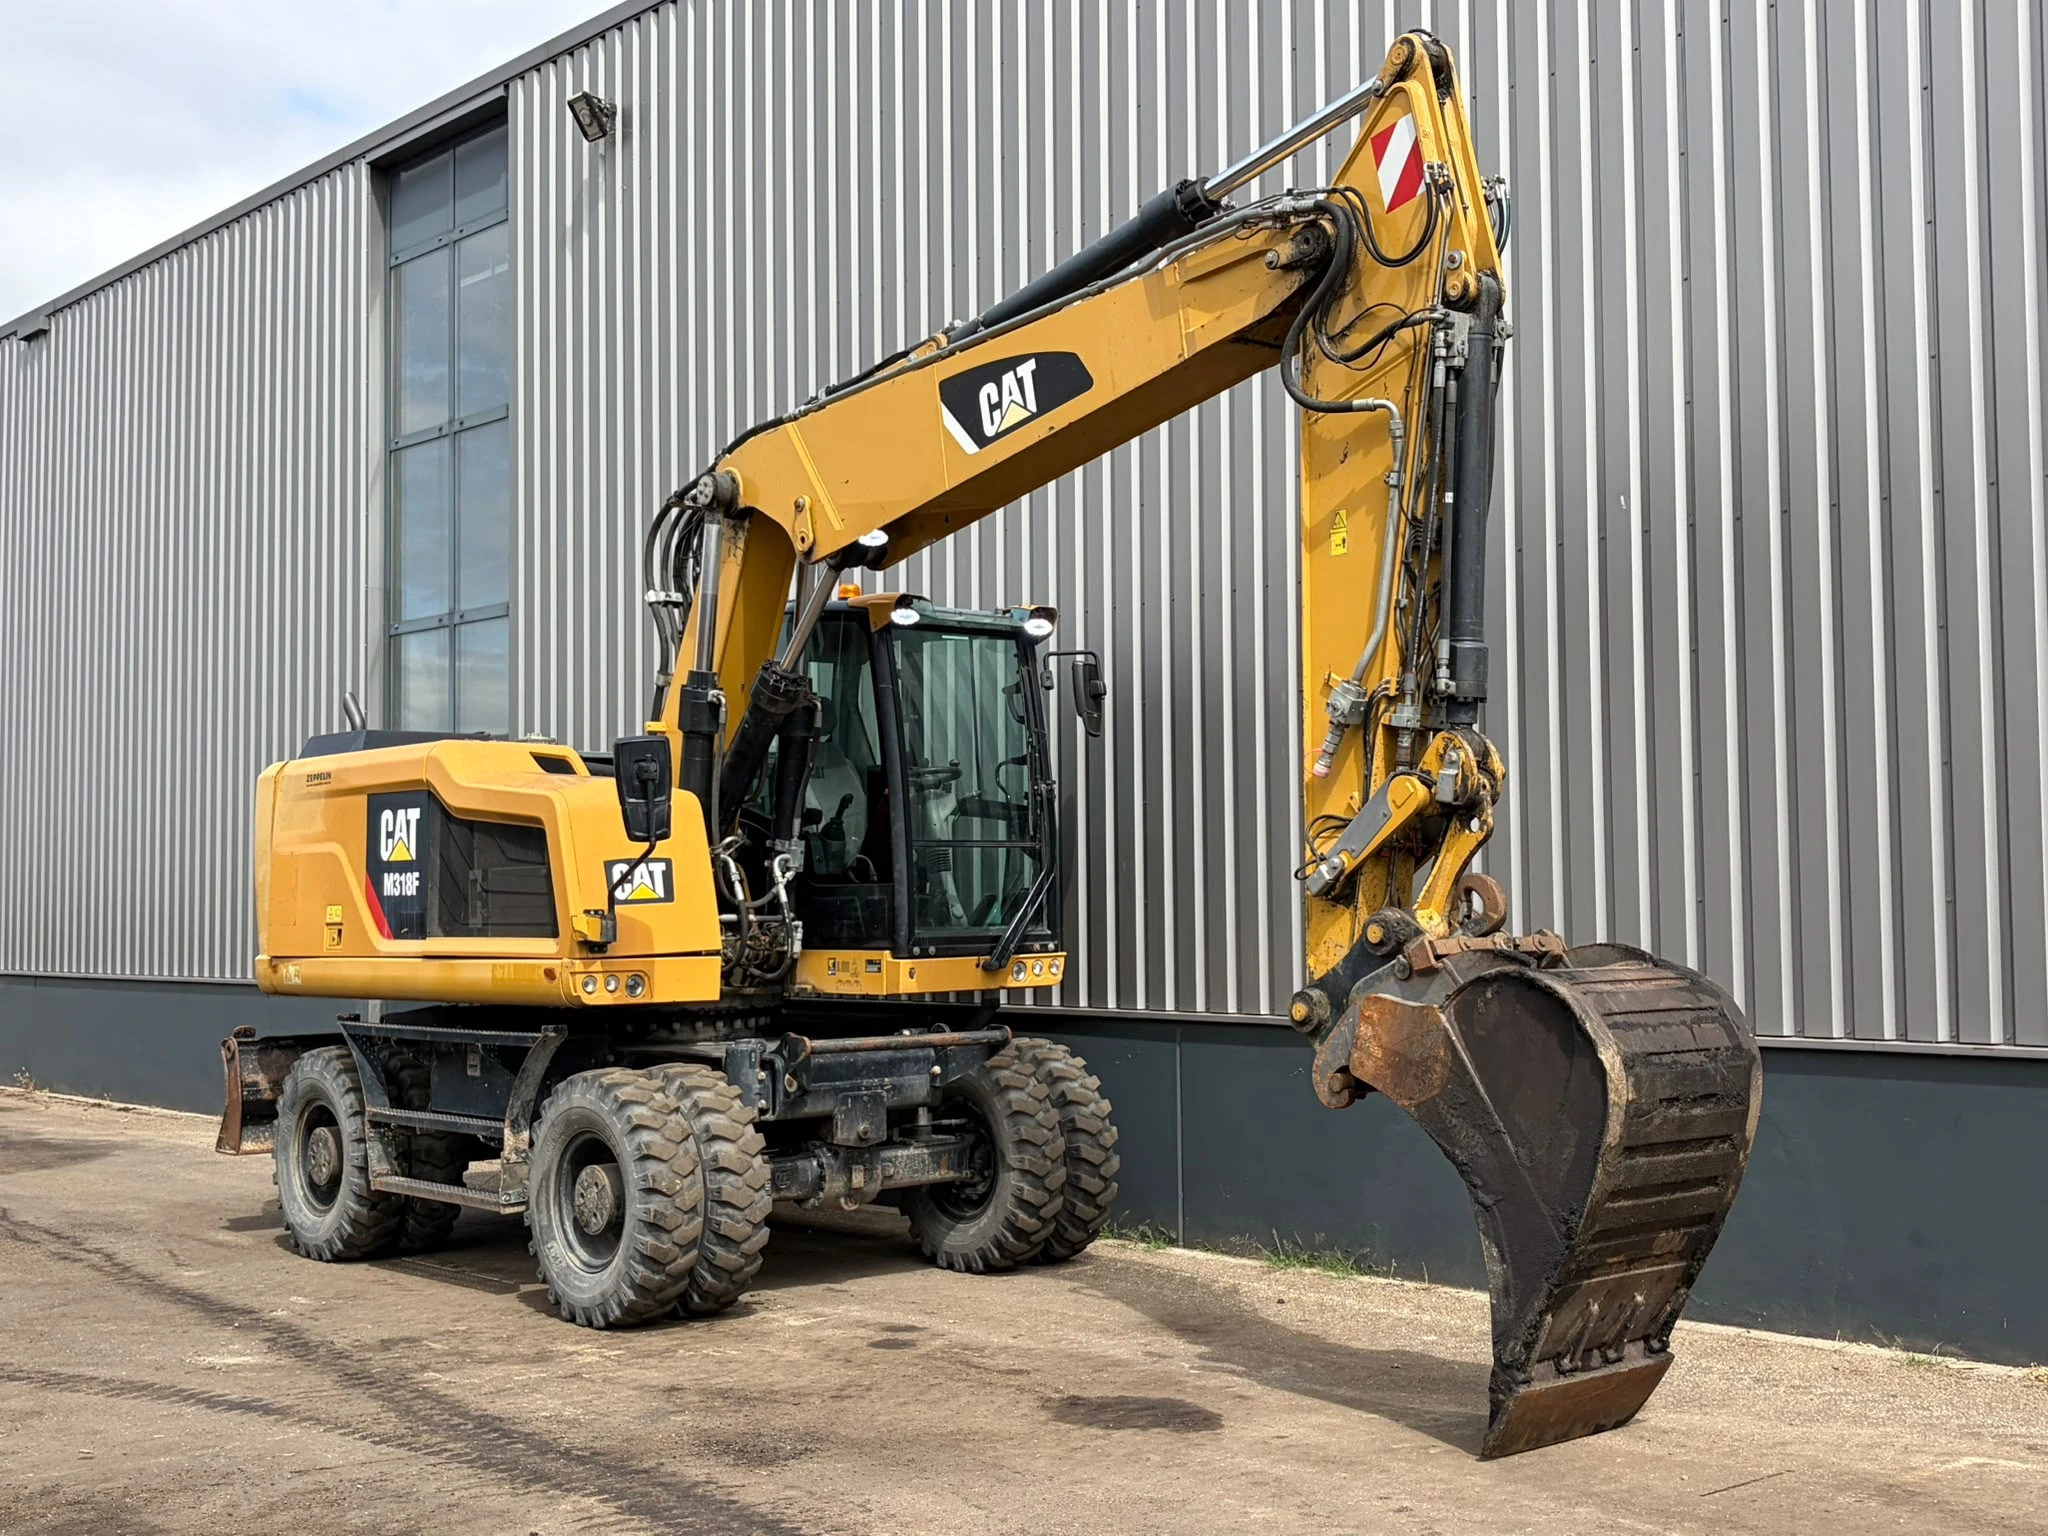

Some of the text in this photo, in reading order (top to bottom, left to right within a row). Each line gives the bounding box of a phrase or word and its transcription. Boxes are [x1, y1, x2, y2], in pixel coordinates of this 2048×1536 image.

[979, 357, 1037, 437] CAT
[380, 807, 421, 862] CAT
[383, 871, 420, 897] M318F
[612, 862, 667, 900] CAT
